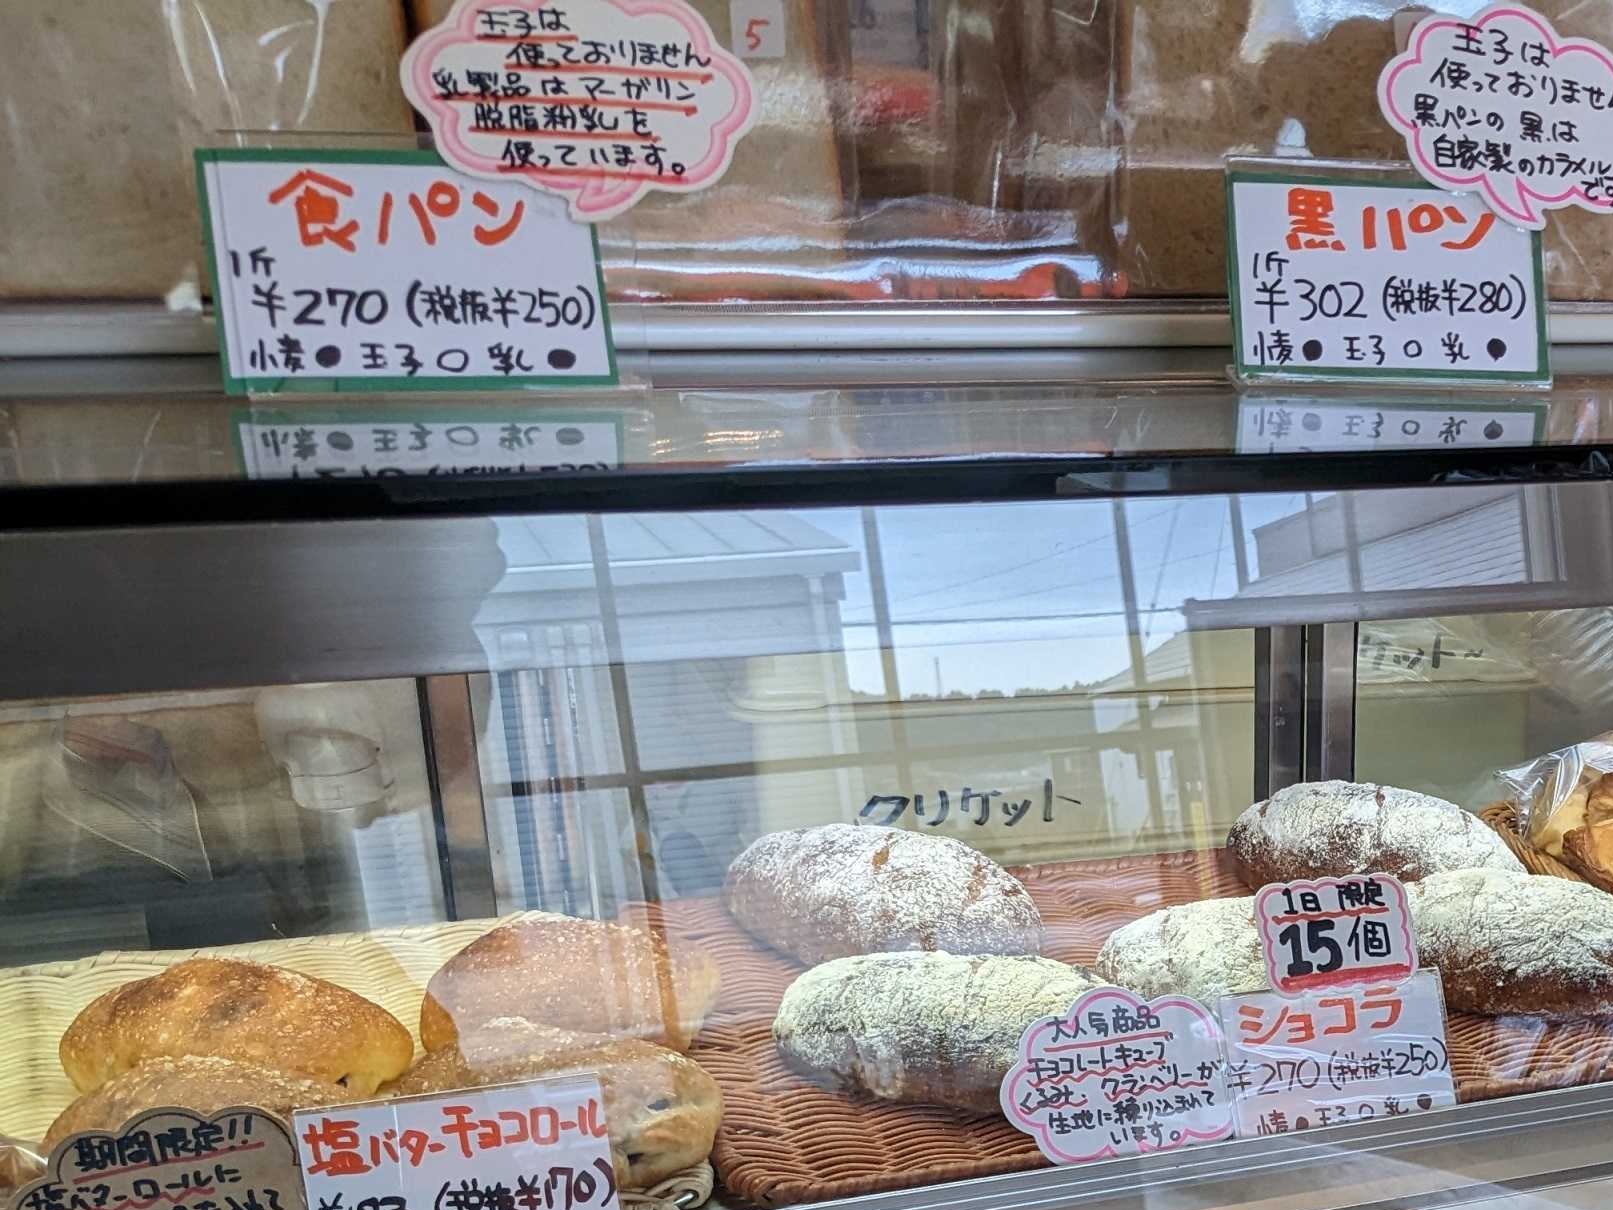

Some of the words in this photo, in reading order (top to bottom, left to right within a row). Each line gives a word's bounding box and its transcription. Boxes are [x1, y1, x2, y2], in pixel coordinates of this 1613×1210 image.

[506, 41, 711, 69] 使っておりません
[745, 19, 770, 52] 5
[1452, 23, 1551, 69] 玉子は
[473, 104, 653, 137] 脱脂粉乳を
[502, 139, 686, 178] 使っています。
[1433, 134, 1611, 176] 自家製のカラメル
[269, 170, 524, 252] 食パン
[1285, 187, 1495, 251] 黒パン
[252, 281, 388, 328] ¥270
[1254, 278, 1367, 323] ¥302
[1279, 916, 1391, 977] 15個
[1048, 1005, 1161, 1042] 大人気商品
[1238, 987, 1402, 1044] ショコラ
[1029, 1032, 1174, 1080] チョコレートキューブ
[1227, 1056, 1320, 1095] ¥270
[303, 1099, 608, 1175] 塩バターチョコロール
